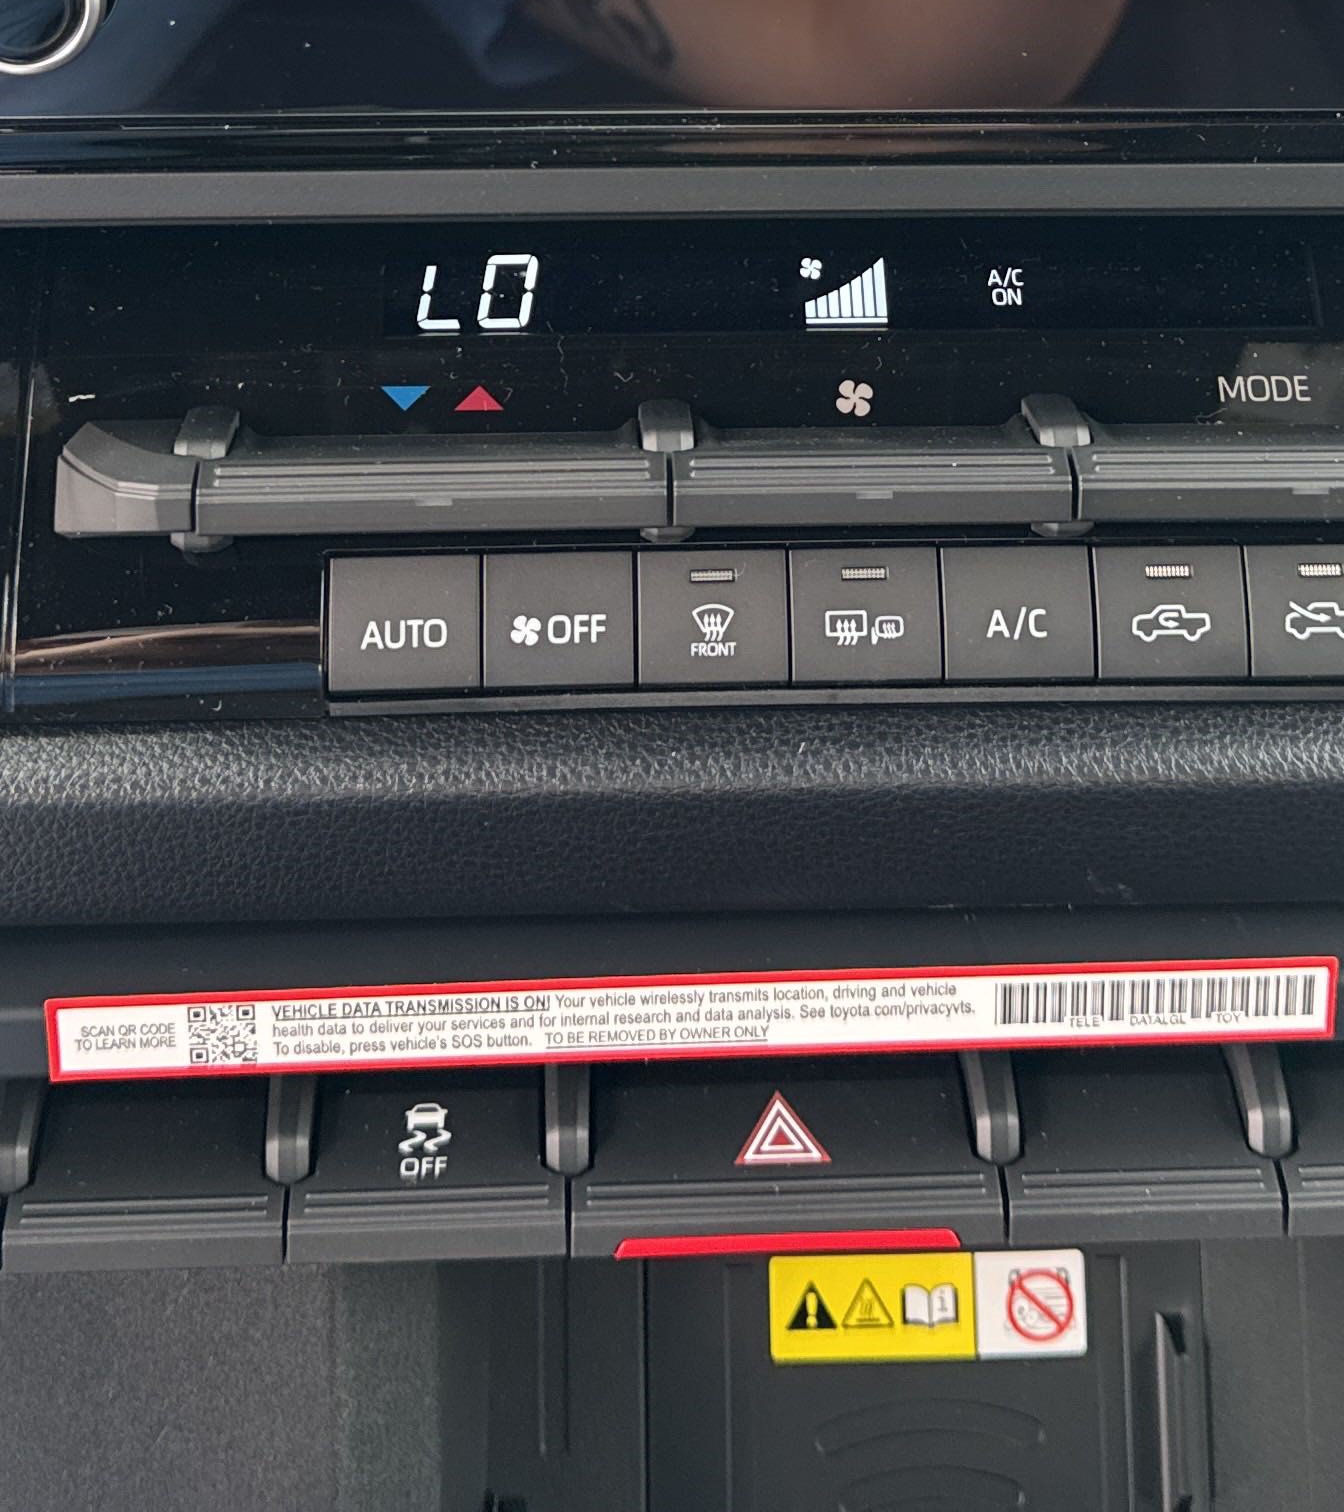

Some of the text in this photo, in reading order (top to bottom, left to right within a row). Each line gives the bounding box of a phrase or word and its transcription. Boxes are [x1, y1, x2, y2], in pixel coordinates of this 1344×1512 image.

[987, 267, 1025, 288] A/C
[991, 287, 1023, 306] ON
[1217, 374, 1312, 403] MODE
[360, 618, 448, 650] AUTO
[547, 614, 607, 644] OFF
[986, 606, 1048, 641] A/C
[690, 641, 737, 657] FRONT
[272, 1002, 337, 1019] VEHICLE
[342, 1001, 383, 1017] DATA
[385, 996, 501, 1015] TRANSMISSION
[506, 995, 519, 1010] IS
[555, 993, 585, 1008] Your
[590, 991, 636, 1007] vehicle
[640, 989, 705, 1007] wirelessly
[709, 987, 769, 1003] transmits
[832, 984, 877, 1001] driving
[881, 983, 906, 997] and
[911, 981, 957, 996] vehicle
[80, 1022, 176, 1038] SCAN QR CODE
[272, 1022, 313, 1037] health
[317, 1021, 347, 1036] data
[352, 1021, 365, 1034] to
[369, 1019, 414, 1033] deliver
[418, 1020, 447, 1036] your
[451, 1015, 506, 1031] services
[510, 1014, 535, 1028] and
[539, 1012, 557, 1028] for
[560, 1011, 610, 1026] internal
[614, 1009, 671, 1025] research
[676, 1008, 700, 1023] and
[705, 1007, 733, 1022] data
[738, 1005, 795, 1023] analysis.
[799, 1004, 825, 1019] See
[1215, 1011, 1242, 1024] TOY
[75, 1035, 177, 1051] TO LEARN MORE
[273, 1024, 770, 1056] To disable, press vehicle's SOS button. TO BE REMOVED BY OWNER ONLY
[400, 1155, 448, 1181] OFF
